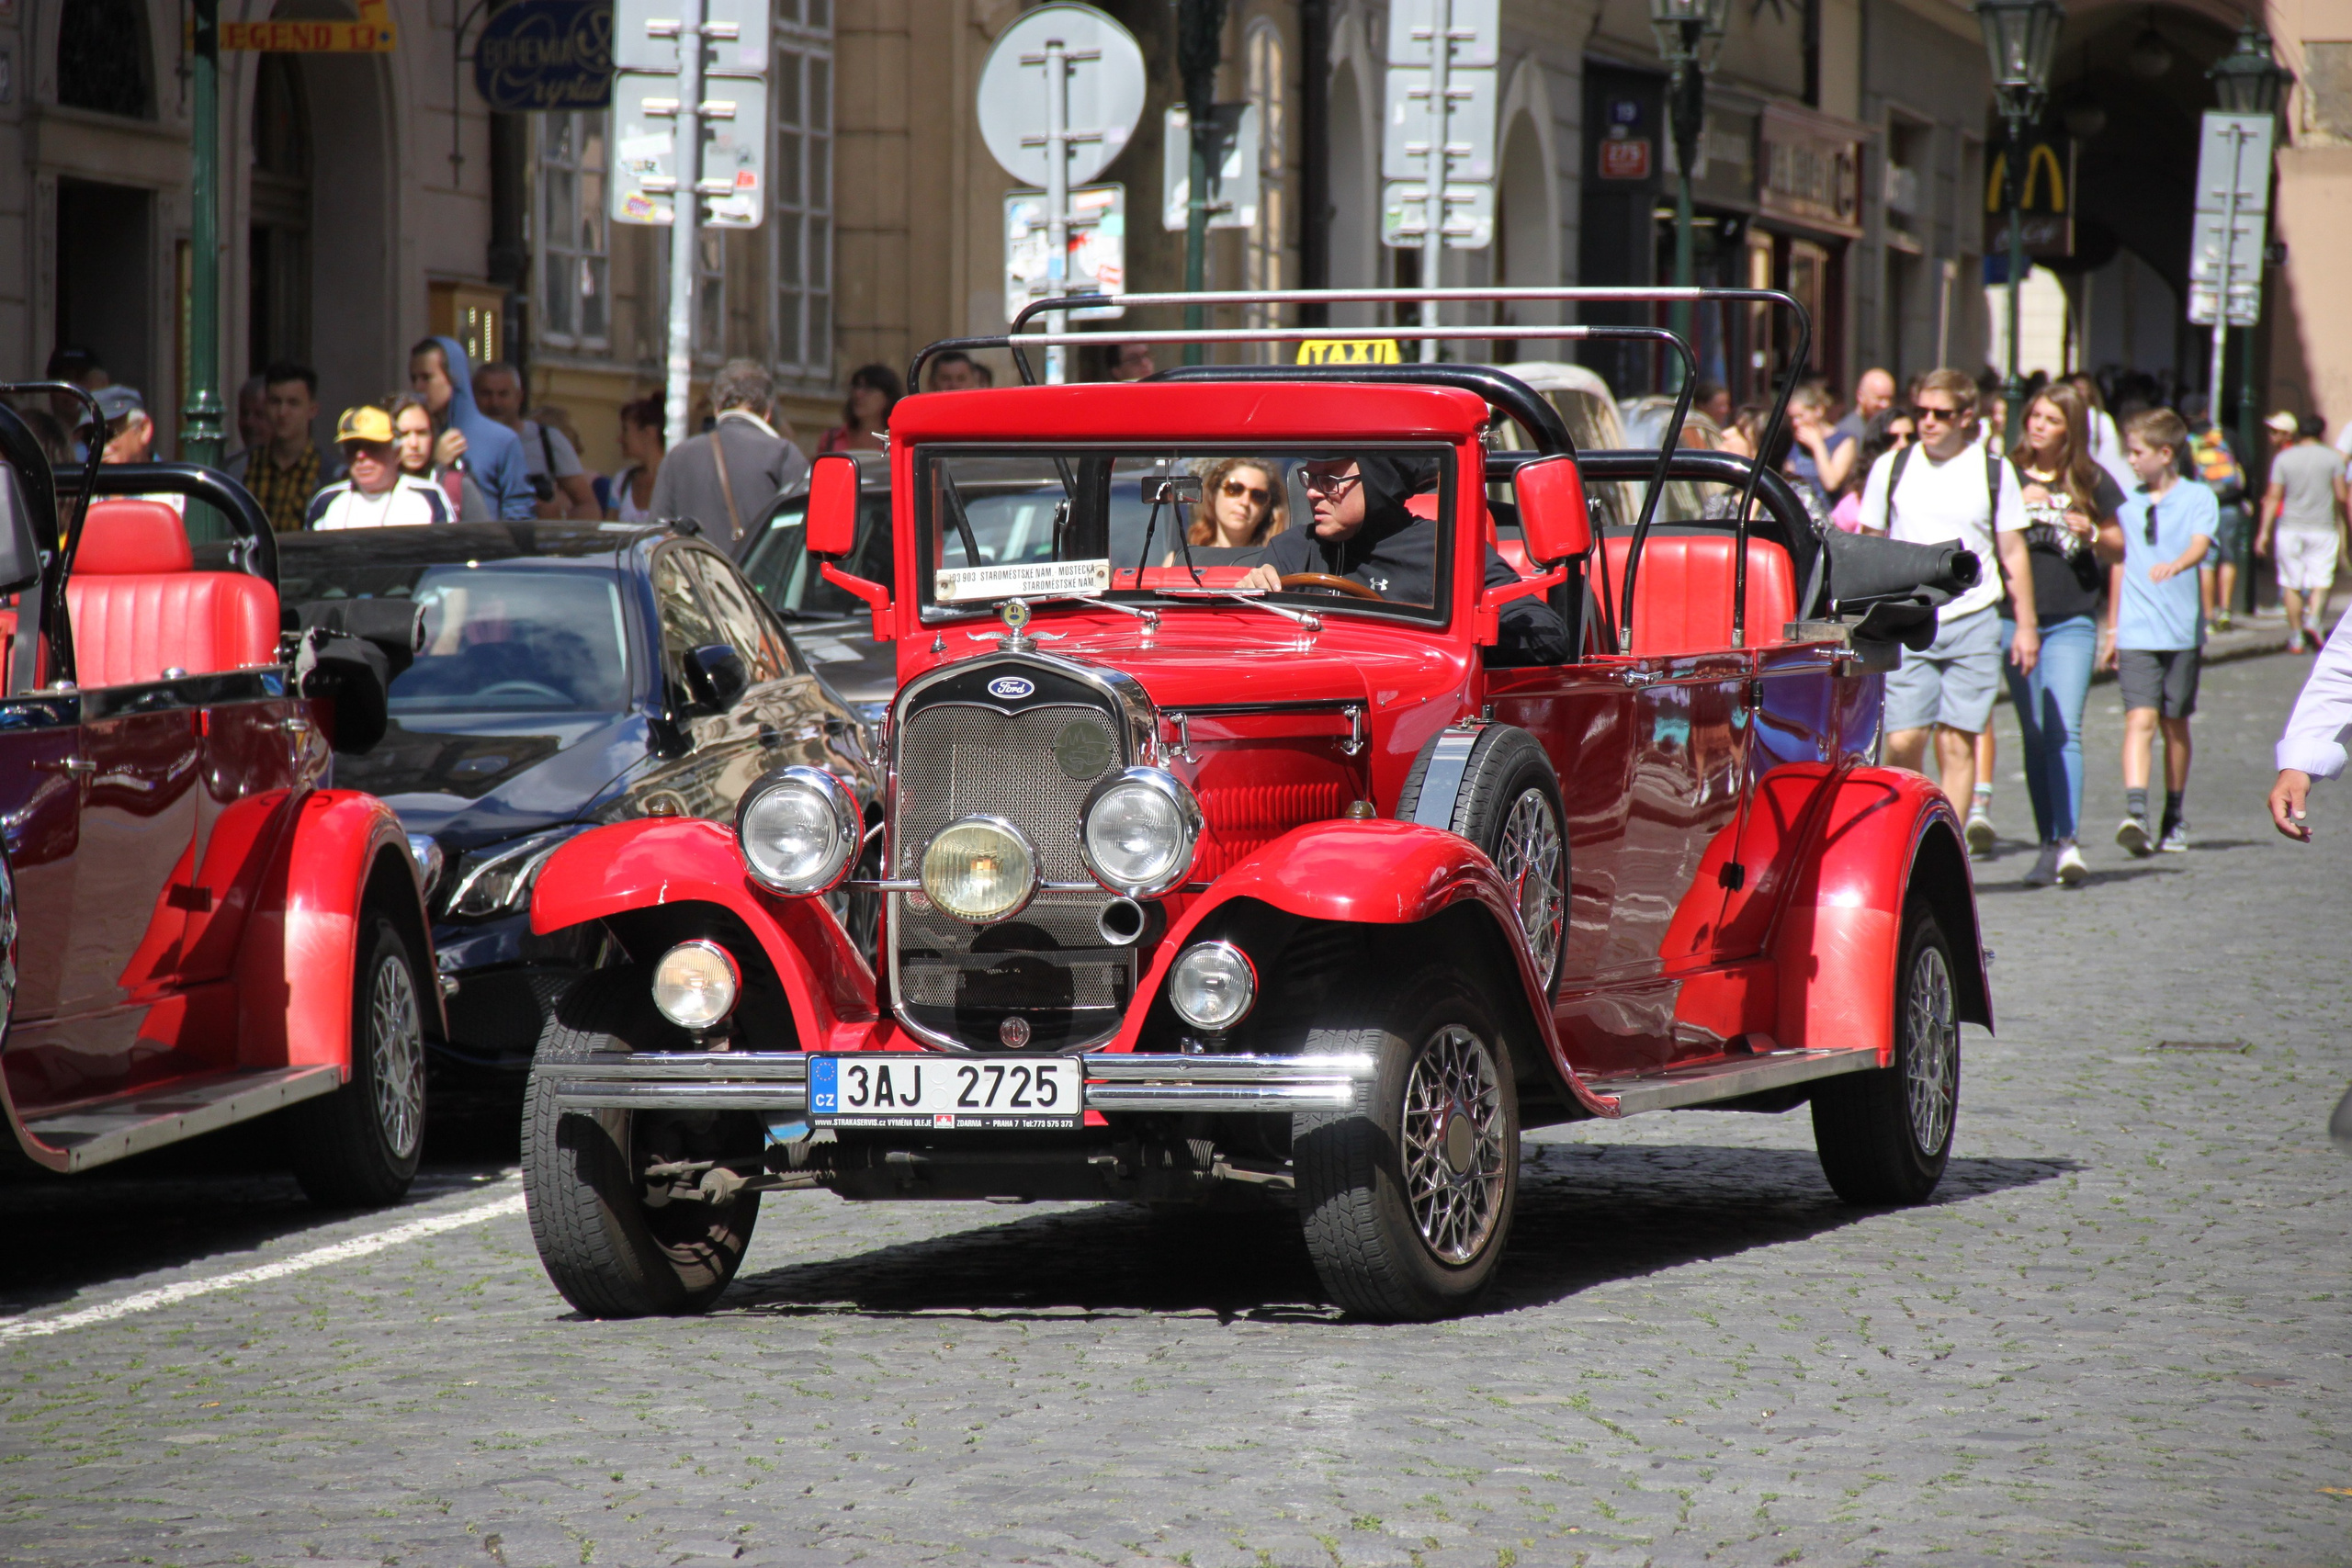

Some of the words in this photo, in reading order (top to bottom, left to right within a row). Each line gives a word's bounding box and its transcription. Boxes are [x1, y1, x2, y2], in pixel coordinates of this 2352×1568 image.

[220, 24, 332, 51] EGEND
[1311, 344, 1384, 365] TAXI
[962, 572, 976, 582] 903
[997, 681, 1025, 694] Ford
[847, 1065, 922, 1108] 3AJ
[956, 1065, 1058, 1108] 2725
[815, 1093, 835, 1107] CZ
[914, 1118, 932, 1127] OLEJE
[956, 1119, 982, 1128] ZDARMA
[992, 1119, 1013, 1128] PRAHA
[1014, 1119, 1019, 1128] 7
[1046, 1119, 1059, 1128] 575
[1060, 1119, 1073, 1128] 373
